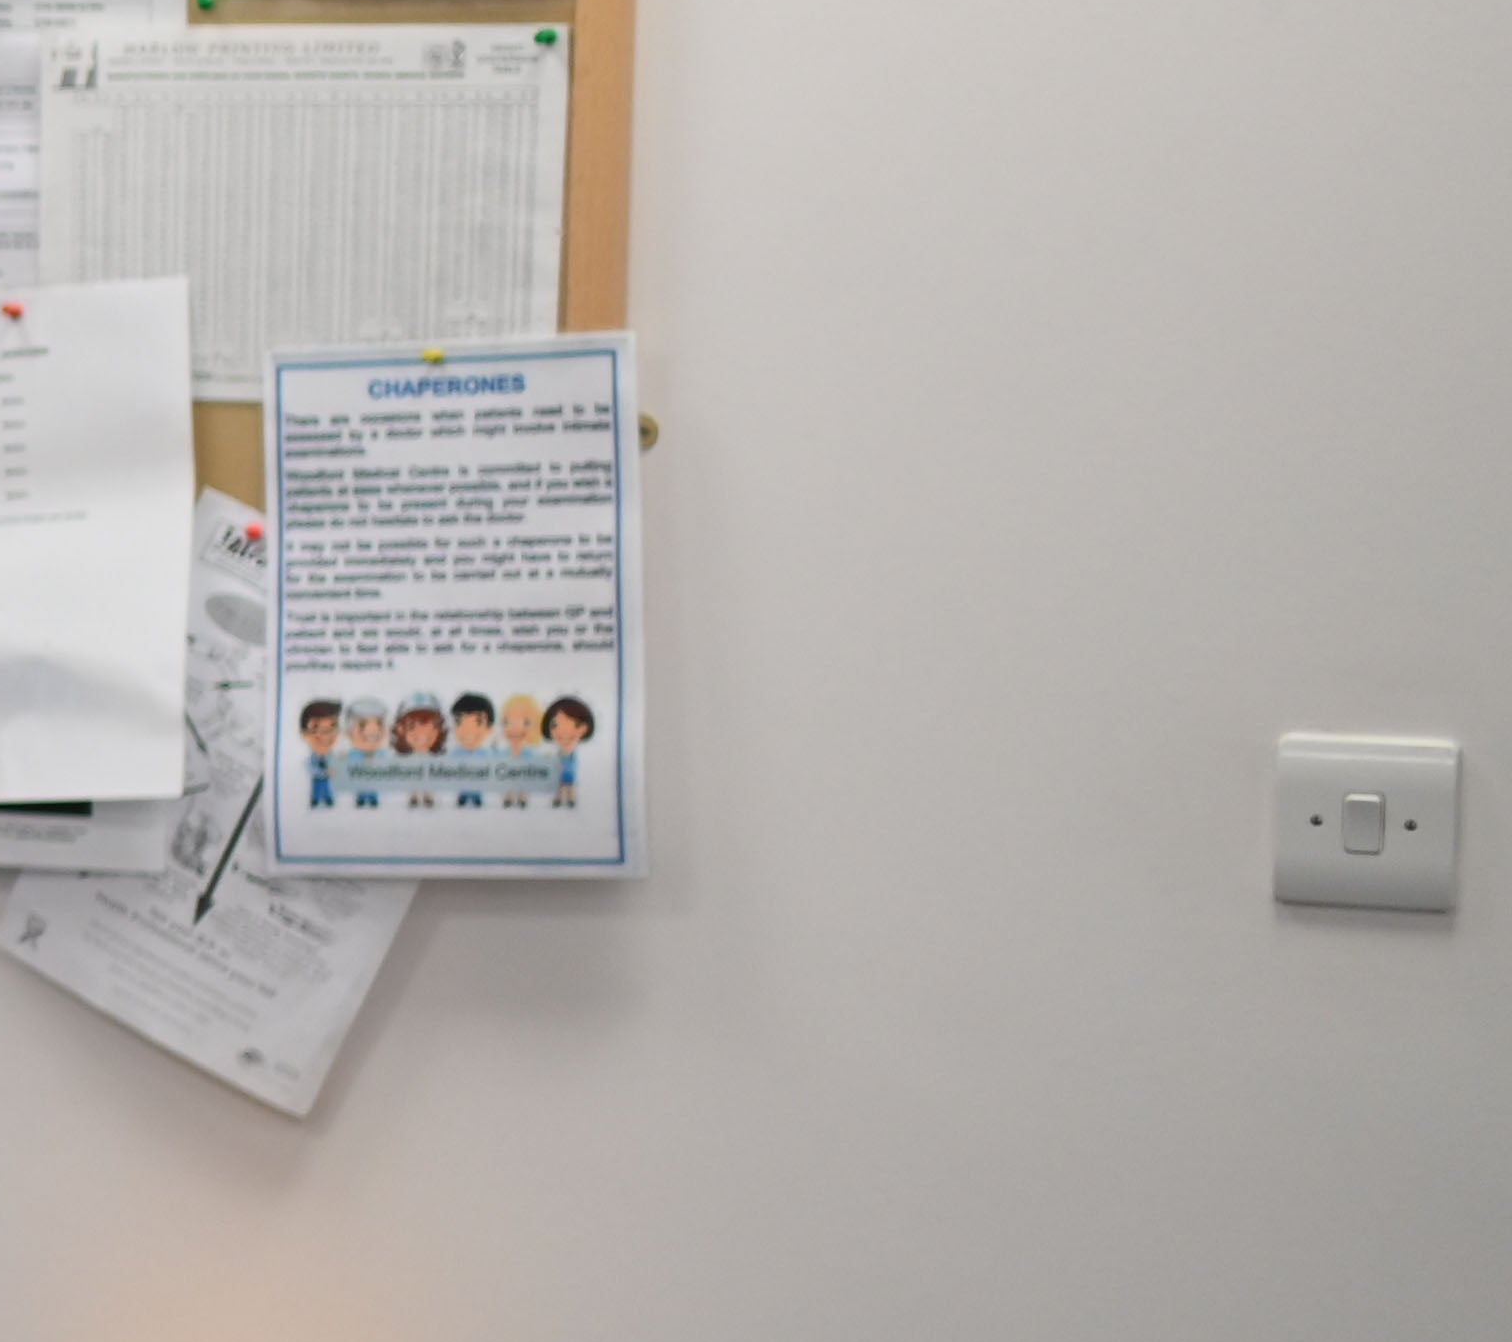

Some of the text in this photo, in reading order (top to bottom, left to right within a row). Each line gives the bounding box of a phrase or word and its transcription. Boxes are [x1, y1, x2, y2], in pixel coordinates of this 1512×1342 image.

[367, 372, 526, 400] CHAPERONES
[347, 763, 549, 781] Woodford Medical Centre
